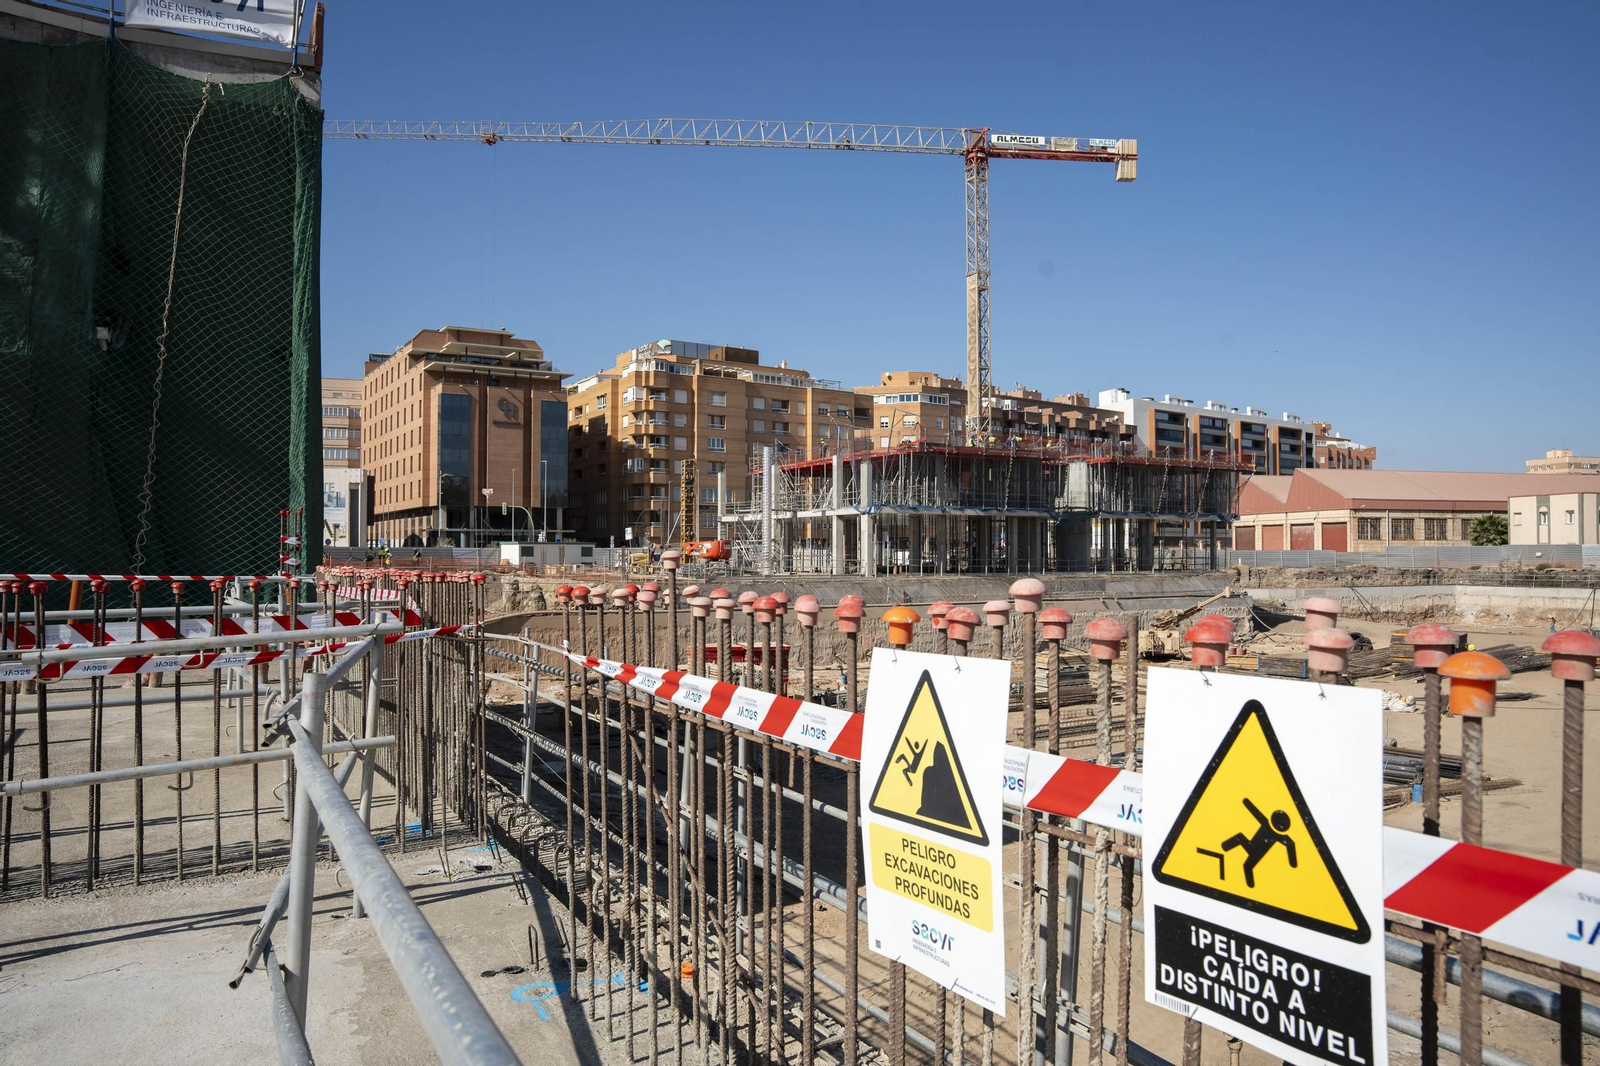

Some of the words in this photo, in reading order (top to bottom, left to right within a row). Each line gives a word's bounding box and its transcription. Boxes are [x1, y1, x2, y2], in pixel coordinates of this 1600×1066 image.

[147, 8, 260, 34] INFRAESTRUCTURAS
[216, 12, 222, 20] E
[800, 724, 827, 741] sacyr
[901, 838, 956, 869] PELIGRO
[884, 852, 979, 900] EXCAVACIONES
[895, 876, 970, 919] PROFUNDAS
[912, 919, 955, 951] sacyr
[1190, 925, 1321, 993] ¡PELIGRO!
[1202, 955, 1279, 1004] CAÍDA
[1287, 989, 1307, 1015] A
[1160, 963, 1270, 1025] DISTINTO
[1279, 1010, 1366, 1065] NIVEL
